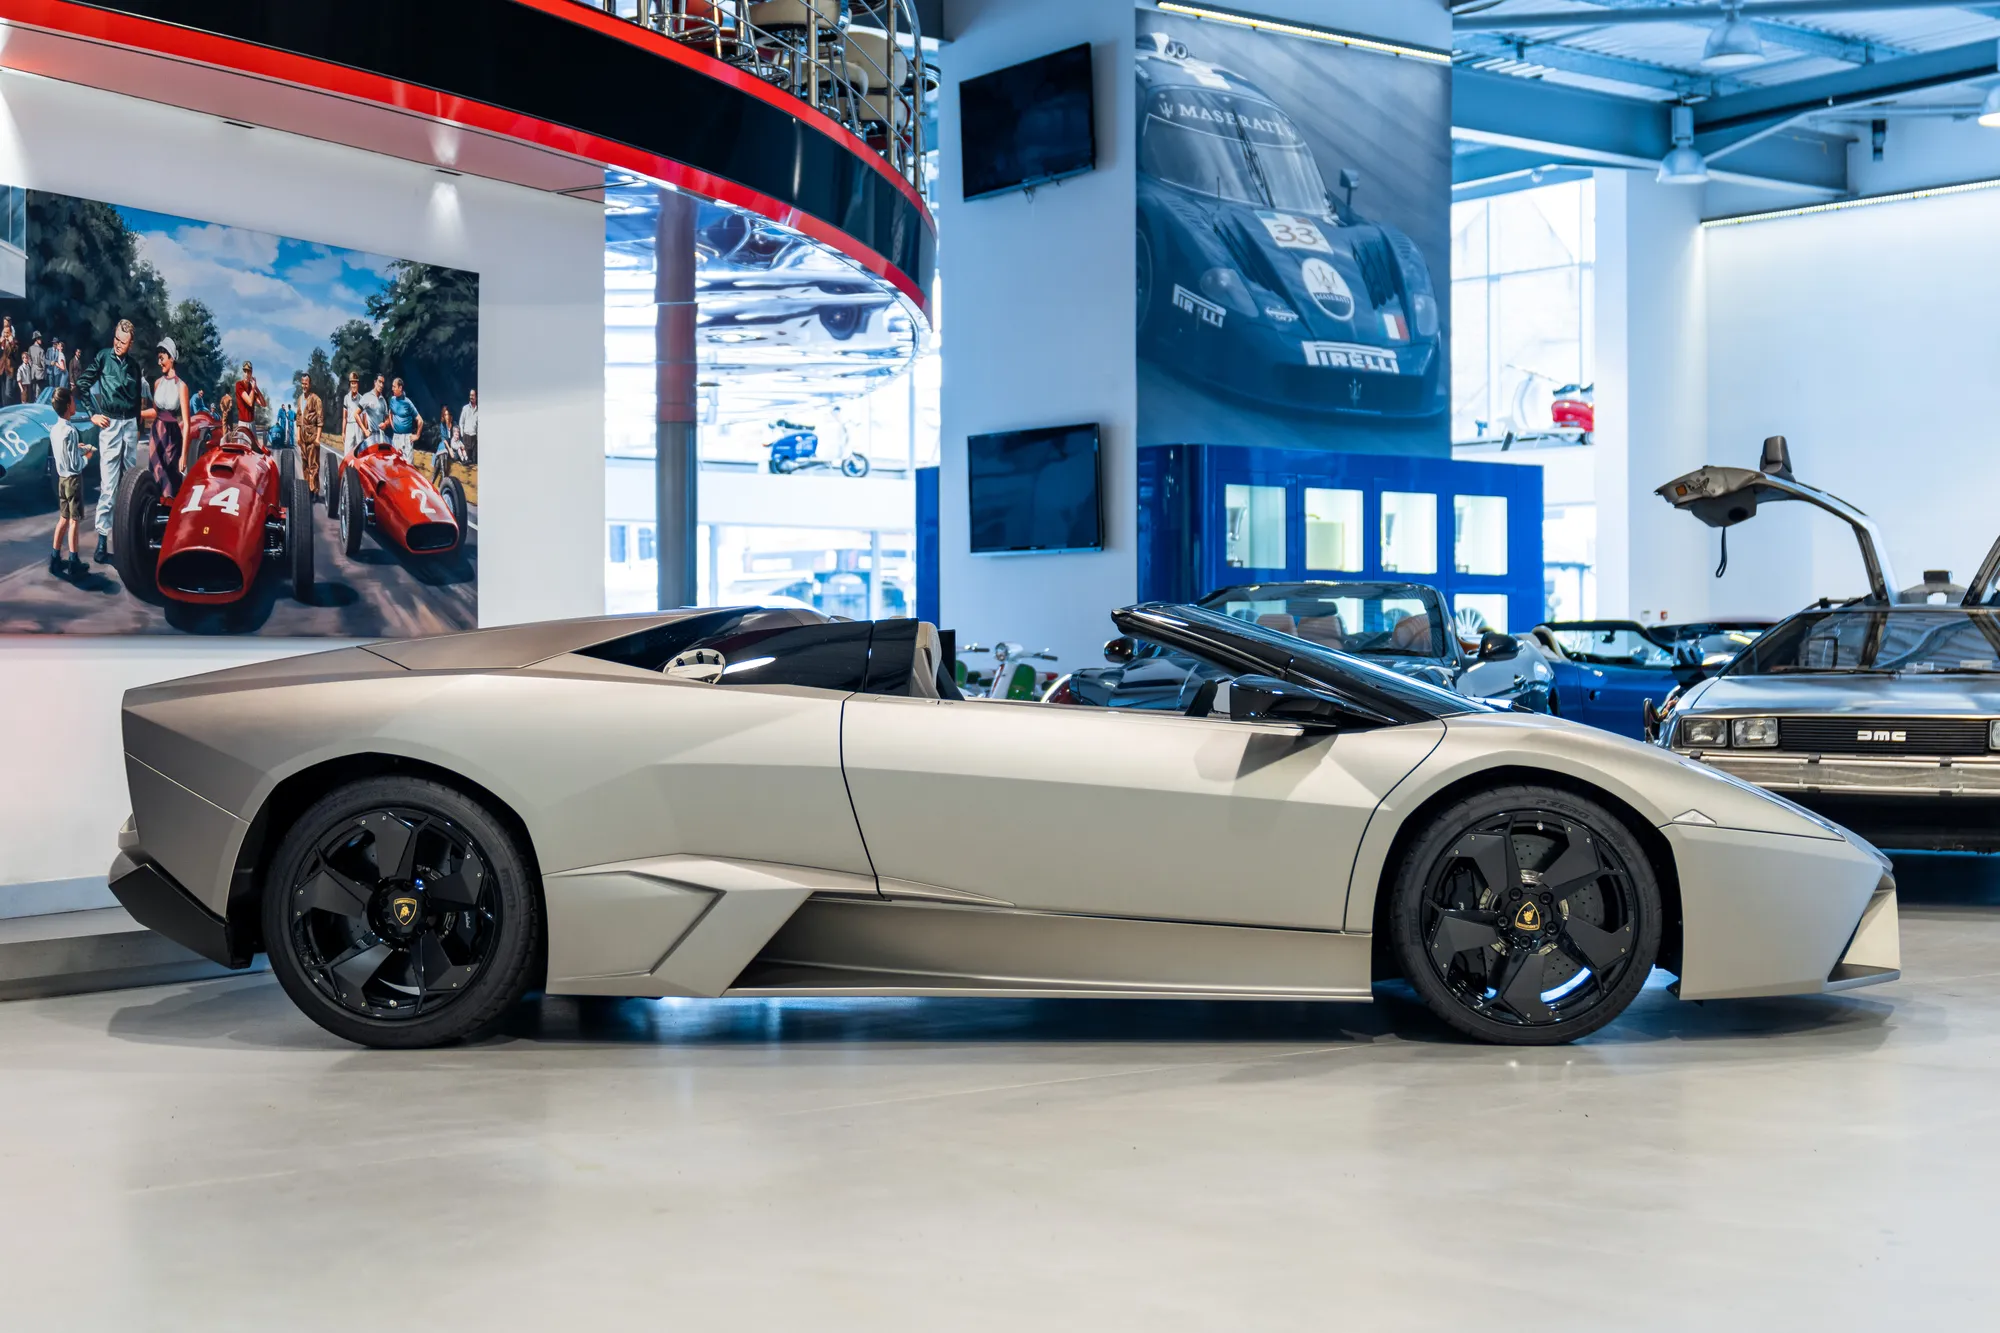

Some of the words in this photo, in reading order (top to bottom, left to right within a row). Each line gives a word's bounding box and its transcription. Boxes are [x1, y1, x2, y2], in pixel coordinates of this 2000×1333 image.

[1179, 103, 1284, 136] MASERATI
[1273, 223, 1317, 246] 33
[1173, 283, 1227, 329] PIRLLI
[1301, 341, 1400, 375] PIRELLI
[0, 430, 29, 457] 18
[180, 484, 240, 517] 14
[410, 488, 437, 514] 2
